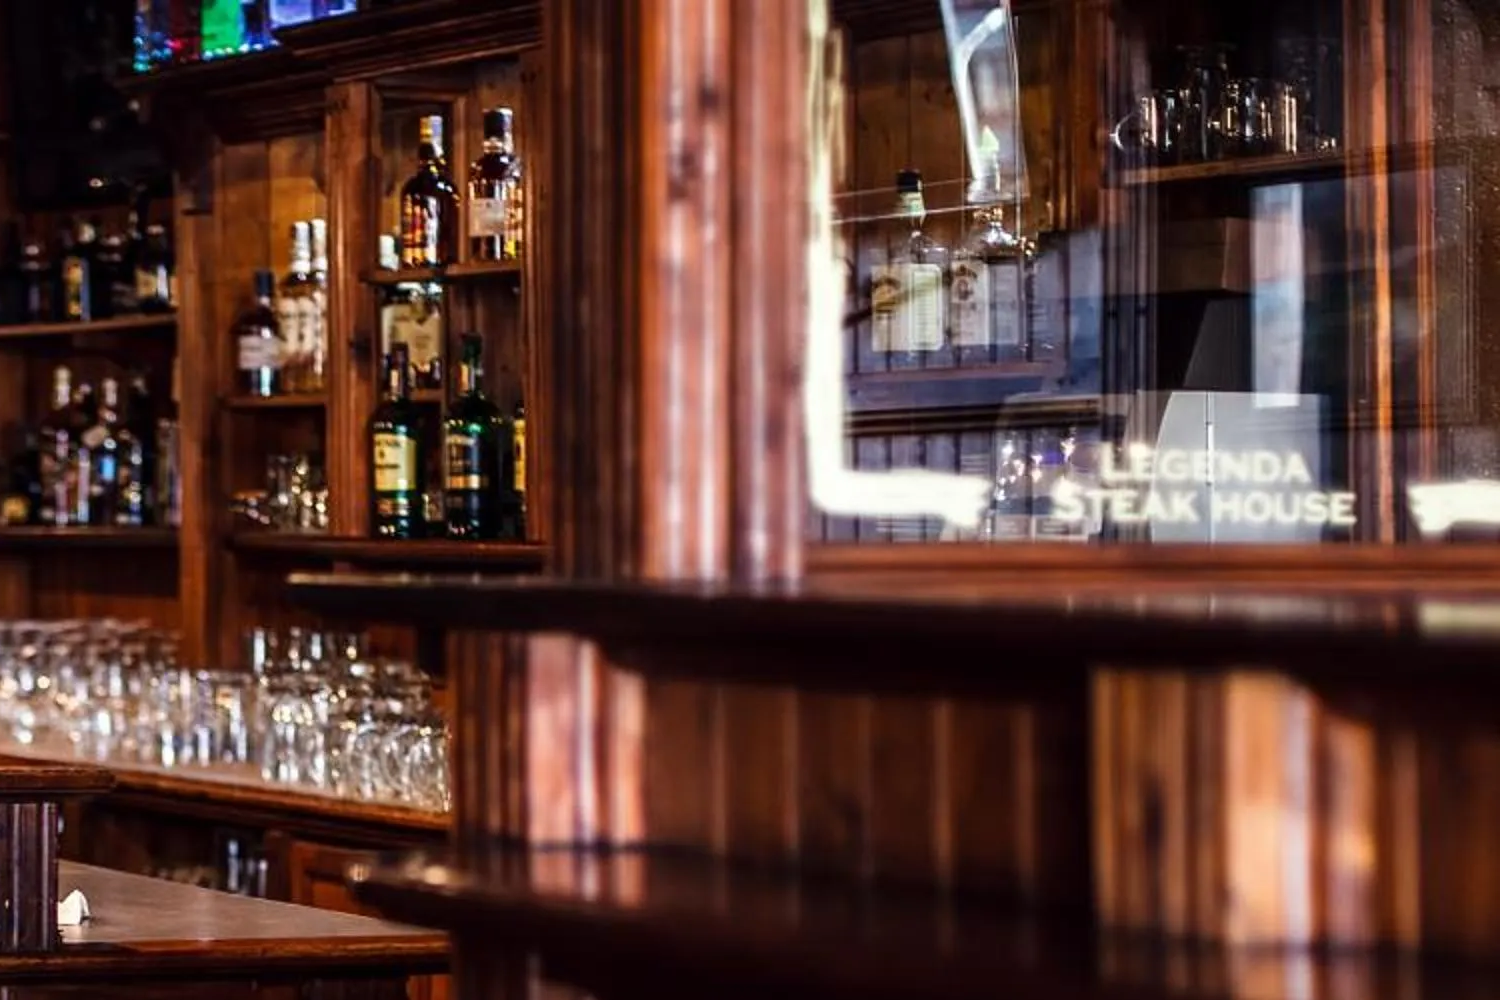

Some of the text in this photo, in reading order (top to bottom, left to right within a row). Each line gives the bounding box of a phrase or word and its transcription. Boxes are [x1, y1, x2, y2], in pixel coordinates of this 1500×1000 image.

[1101, 442, 1311, 484] LEGENDA
[1052, 480, 1358, 525] STEAK HOUSE
